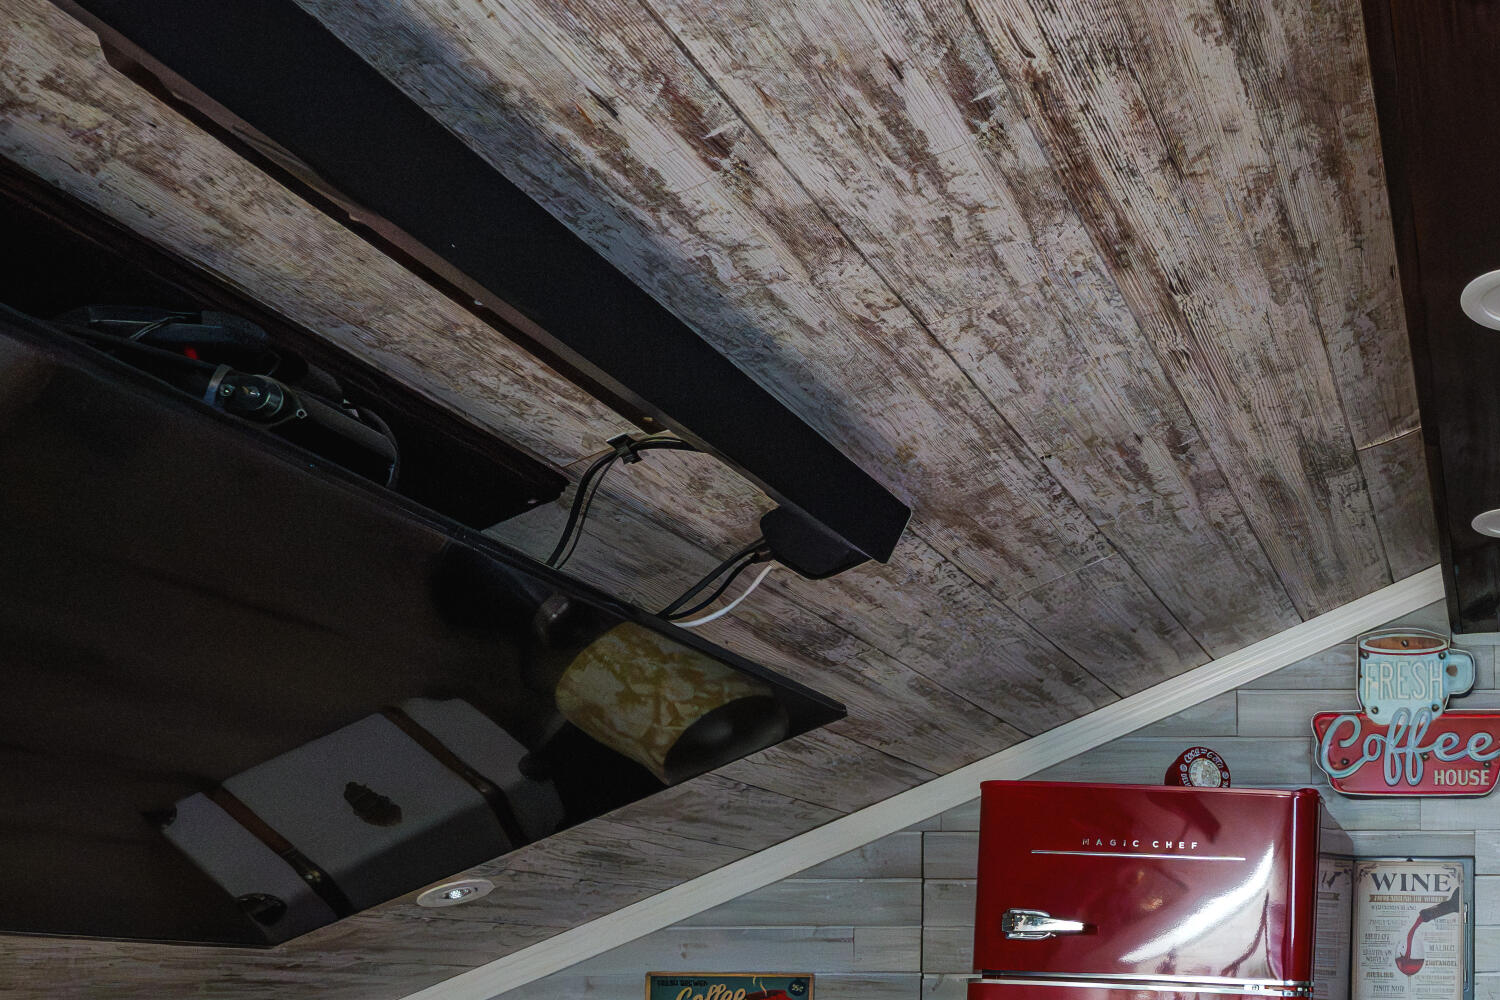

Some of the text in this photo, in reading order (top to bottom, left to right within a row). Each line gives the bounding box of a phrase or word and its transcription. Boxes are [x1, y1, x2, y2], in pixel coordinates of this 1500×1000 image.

[1364, 660, 1444, 701] FRESH
[1433, 769, 1491, 787] HOUSE
[1082, 838, 1199, 851] MAGIC CHEF
[1370, 872, 1452, 893] WINE
